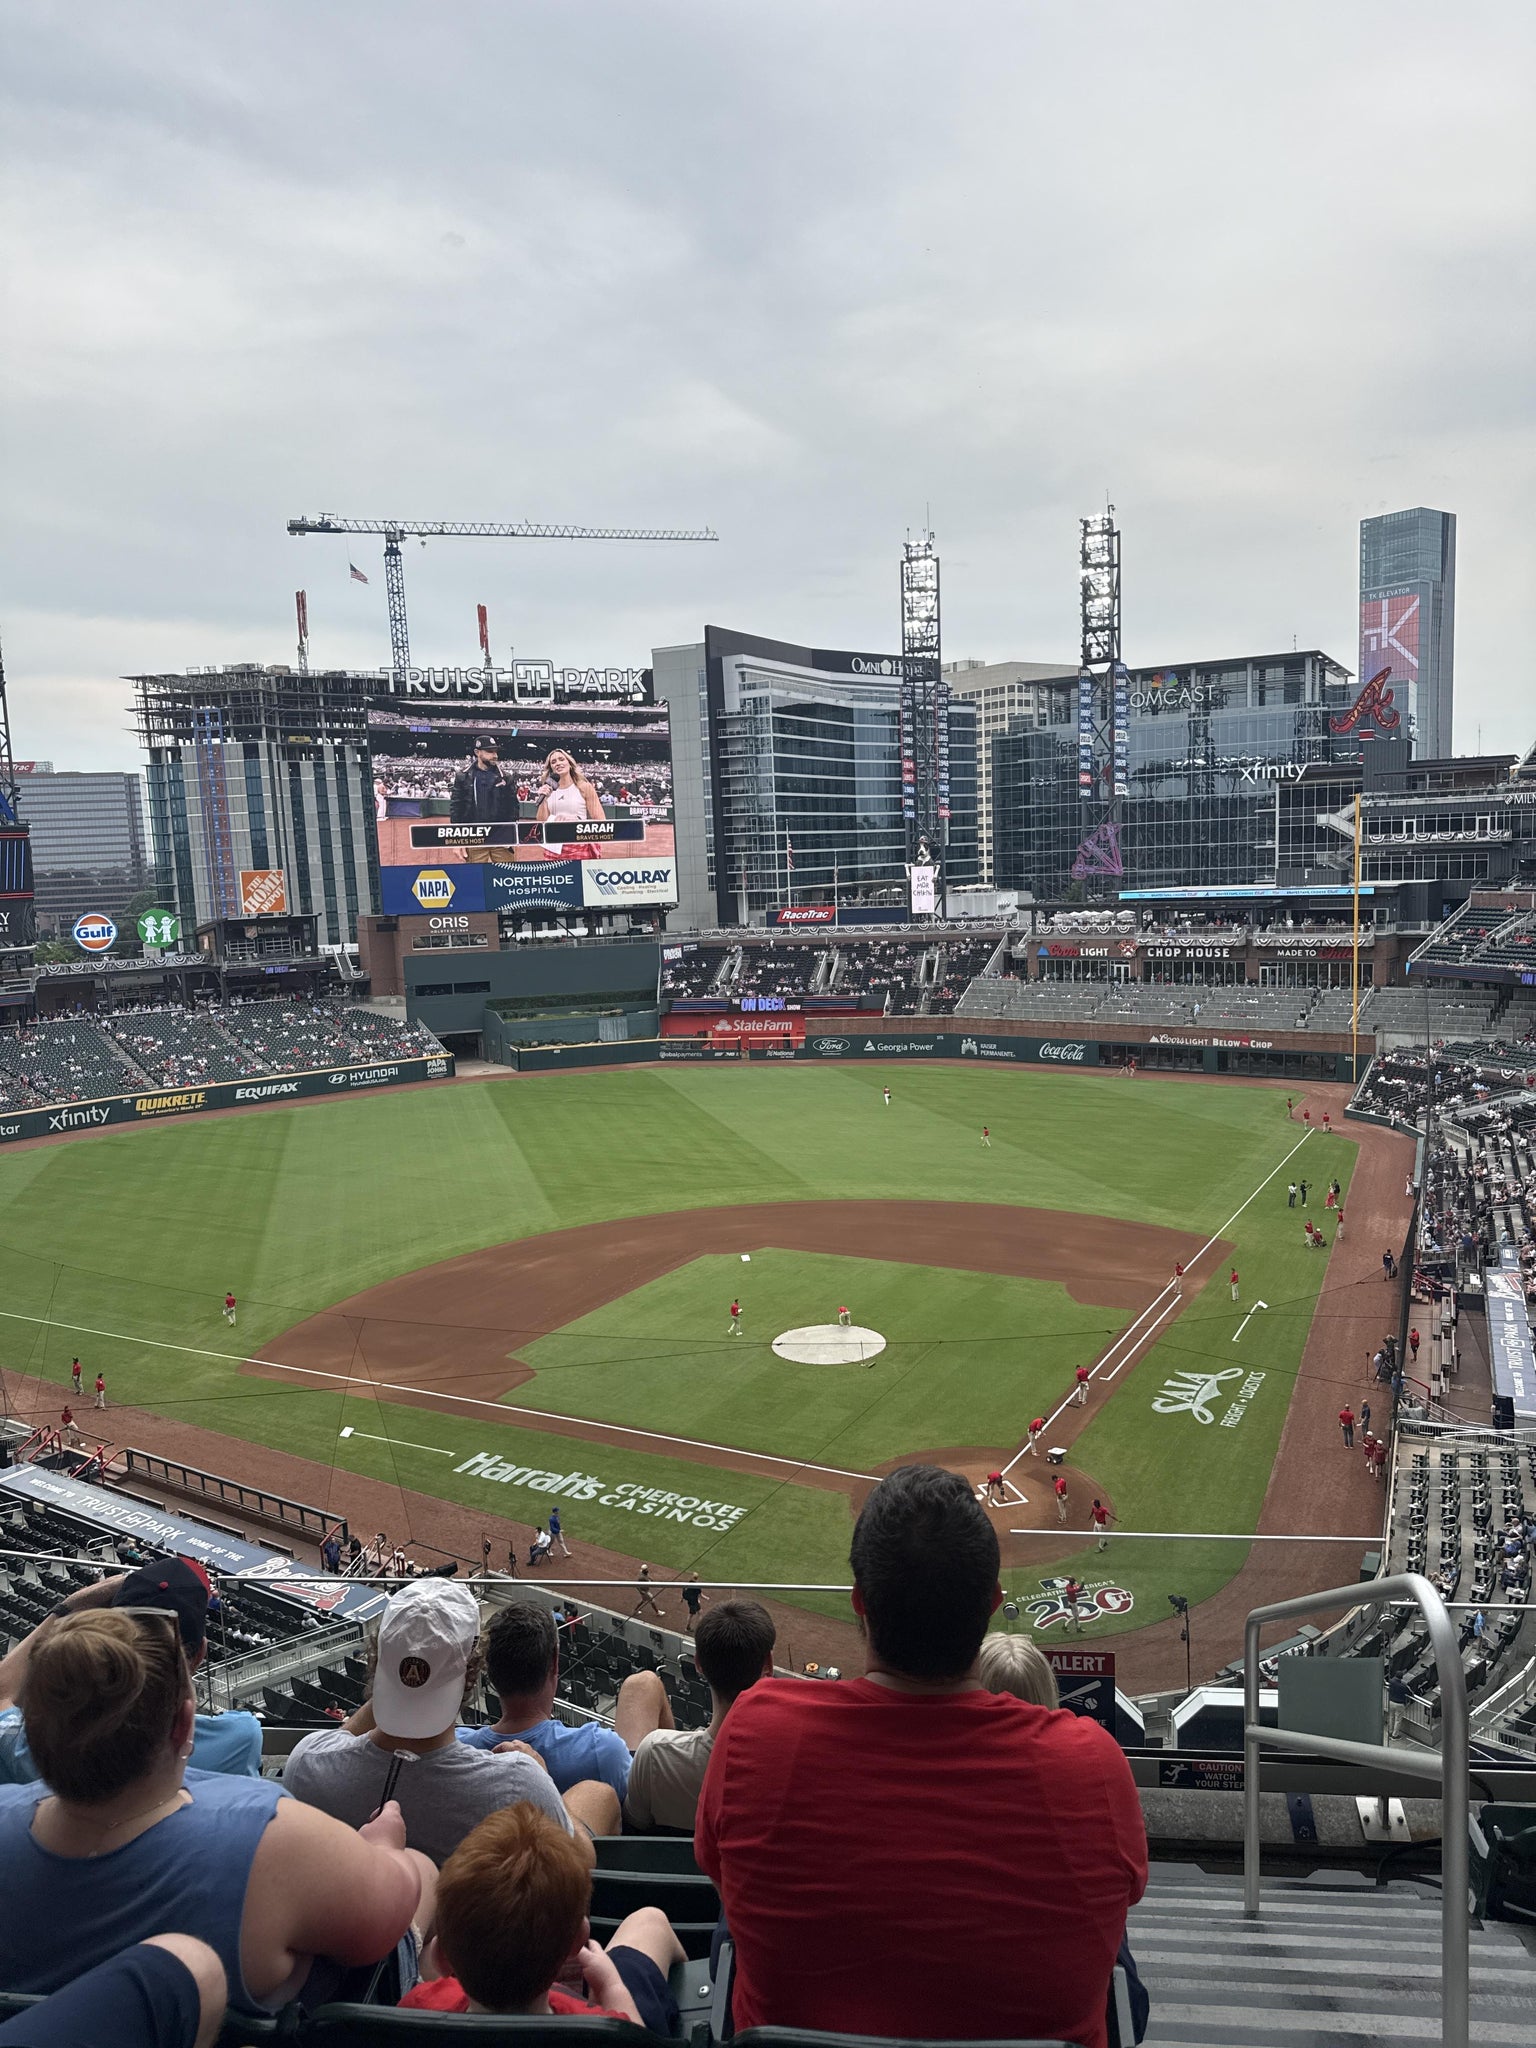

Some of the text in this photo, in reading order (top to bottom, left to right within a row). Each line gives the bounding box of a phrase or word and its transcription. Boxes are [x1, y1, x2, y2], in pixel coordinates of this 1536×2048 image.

[1379, 587, 1410, 598] ELEVATOR
[852, 657, 880, 674] OMNI
[380, 667, 648, 693] TRUIST PARK
[1130, 685, 1216, 708] OMCAST
[1240, 760, 1308, 784] xfinity
[438, 826, 491, 838] BRADLEY
[576, 823, 614, 833] SARAH
[246, 875, 264, 892] THE
[493, 875, 574, 888] NORTHSIDE
[596, 869, 671, 884] COOLRAY
[244, 870, 283, 912] HOME
[419, 880, 449, 898] NAPA
[509, 886, 560, 895] HOSPITAL
[261, 885, 284, 912] DEPOT
[782, 909, 829, 919] RaceTrac
[429, 917, 469, 928] ORIS
[76, 926, 113, 939] Gulf
[1050, 944, 1109, 957] Coors LIGHT
[1148, 947, 1230, 957] CHOP HOUSE
[1277, 949, 1299, 957] MADE
[741, 998, 756, 1011] ON
[758, 997, 786, 1011] DECK
[818, 1039, 843, 1050] Ford
[877, 1042, 934, 1053] Georgia Power
[1160, 1034, 1184, 1044] Coors
[1185, 1038, 1208, 1046] LIGHT
[1213, 1038, 1240, 1047] BELOW
[1250, 1039, 1273, 1048] CHOP
[980, 1050, 1015, 1058] PERMANENTE
[1039, 1042, 1085, 1060] Coca-Cola
[427, 1059, 446, 1068] PAPA
[427, 1066, 447, 1074] JOHNS
[350, 1067, 398, 1081] HYUNDAI
[350, 1078, 389, 1087] HyundaiUSA.com
[235, 1083, 298, 1100] EQUIFAX
[136, 1092, 206, 1111] QUIKRETE
[49, 1105, 110, 1130] xfinity
[1220, 1371, 1266, 1428] FREIGHT LOGISTICS
[29, 1478, 76, 1498] WELCOME TO
[615, 1483, 748, 1520] CHEROKEE
[77, 1495, 186, 1541] TRUIST PARK
[599, 1494, 735, 1532] CASINOS
[186, 1537, 245, 1562] HOME OF THE
[1016, 1580, 1115, 1603] CELEBRATIN ERICA'S
[1051, 1655, 1105, 1671] ALERT
[1199, 1763, 1242, 1772] CAUTION
[1204, 1773, 1236, 1781] WATCH
[1222, 1781, 1244, 1789] STEP
